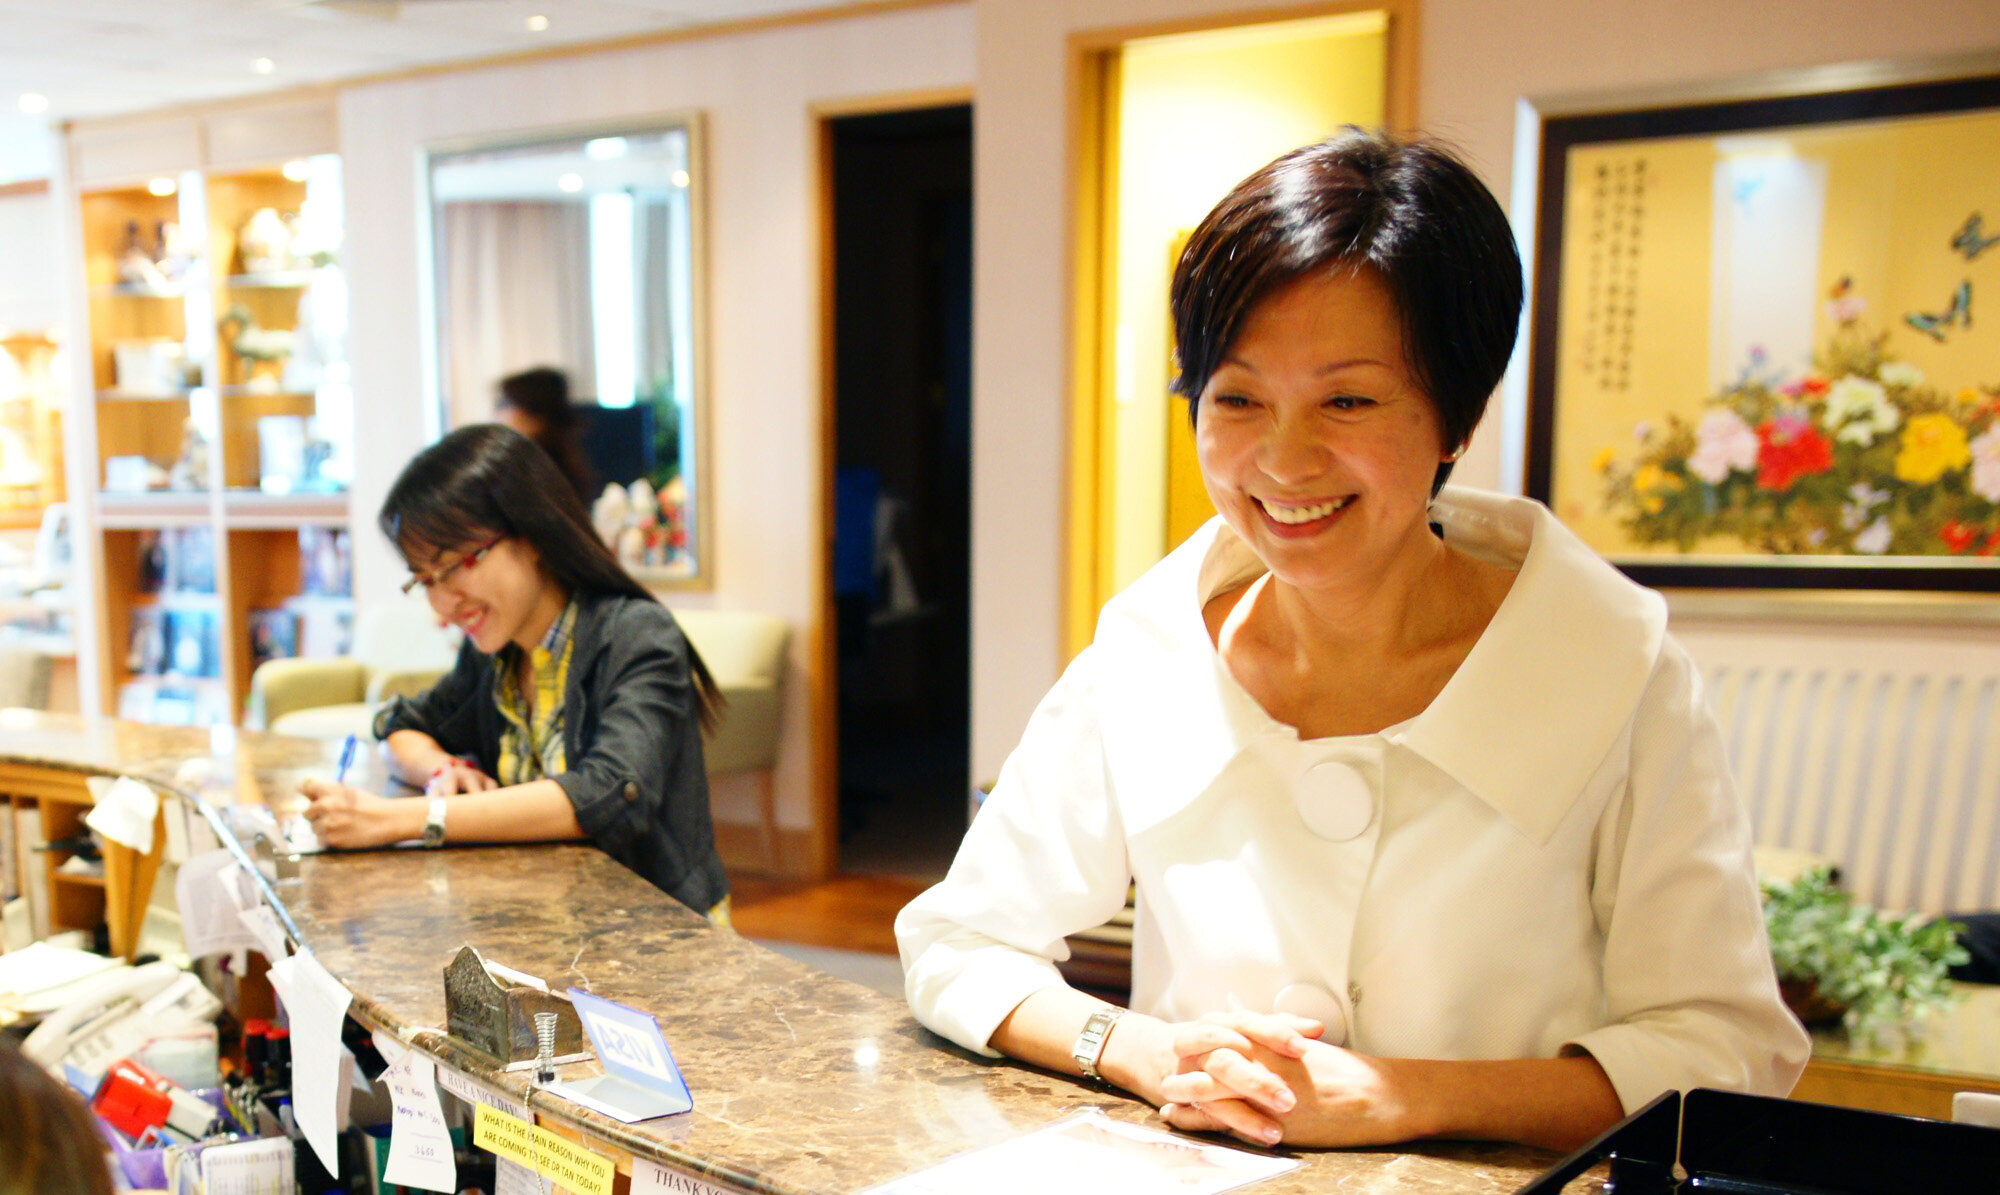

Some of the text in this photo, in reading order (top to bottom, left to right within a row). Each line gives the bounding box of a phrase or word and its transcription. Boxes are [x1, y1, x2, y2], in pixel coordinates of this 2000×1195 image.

[447, 1073, 469, 1094] HAVE
[476, 1088, 496, 1110] NICE
[483, 1112, 504, 1130] WHAT
[505, 1122, 512, 1133] IS
[513, 1125, 526, 1138] THE
[547, 1141, 573, 1164] REASON
[574, 1153, 590, 1170] WHY
[591, 1161, 605, 1179] YOU
[484, 1130, 497, 1144] ARE
[498, 1137, 528, 1157] COMING
[540, 1154, 552, 1168] SEE
[551, 1158, 560, 1173] DR
[561, 1165, 575, 1182] TAN
[576, 1173, 602, 1194] TODAY?
[654, 1167, 702, 1195] THANK
